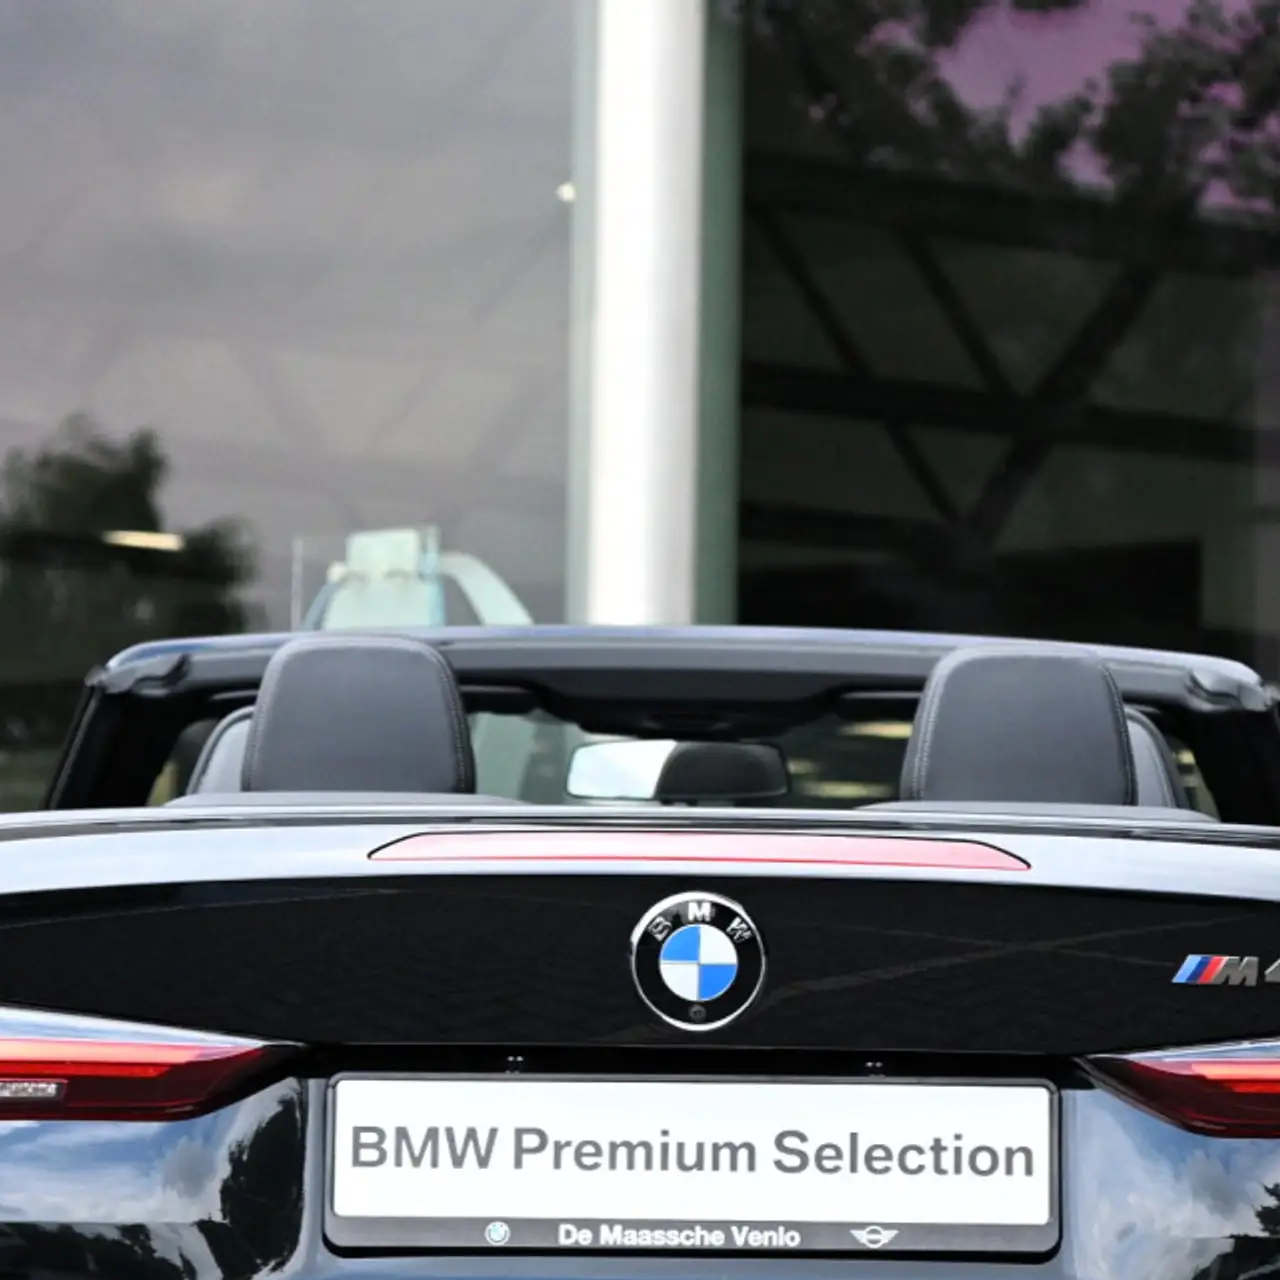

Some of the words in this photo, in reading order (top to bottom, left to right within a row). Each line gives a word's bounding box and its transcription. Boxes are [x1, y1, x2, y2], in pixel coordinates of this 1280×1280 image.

[648, 902, 752, 943] BMW
[351, 1125, 499, 1169] BMW
[513, 1127, 756, 1173] Premium
[773, 1129, 1034, 1177] Selection
[558, 1224, 593, 1246] De
[599, 1224, 726, 1247] Maassche
[730, 1225, 801, 1248] Venlo
